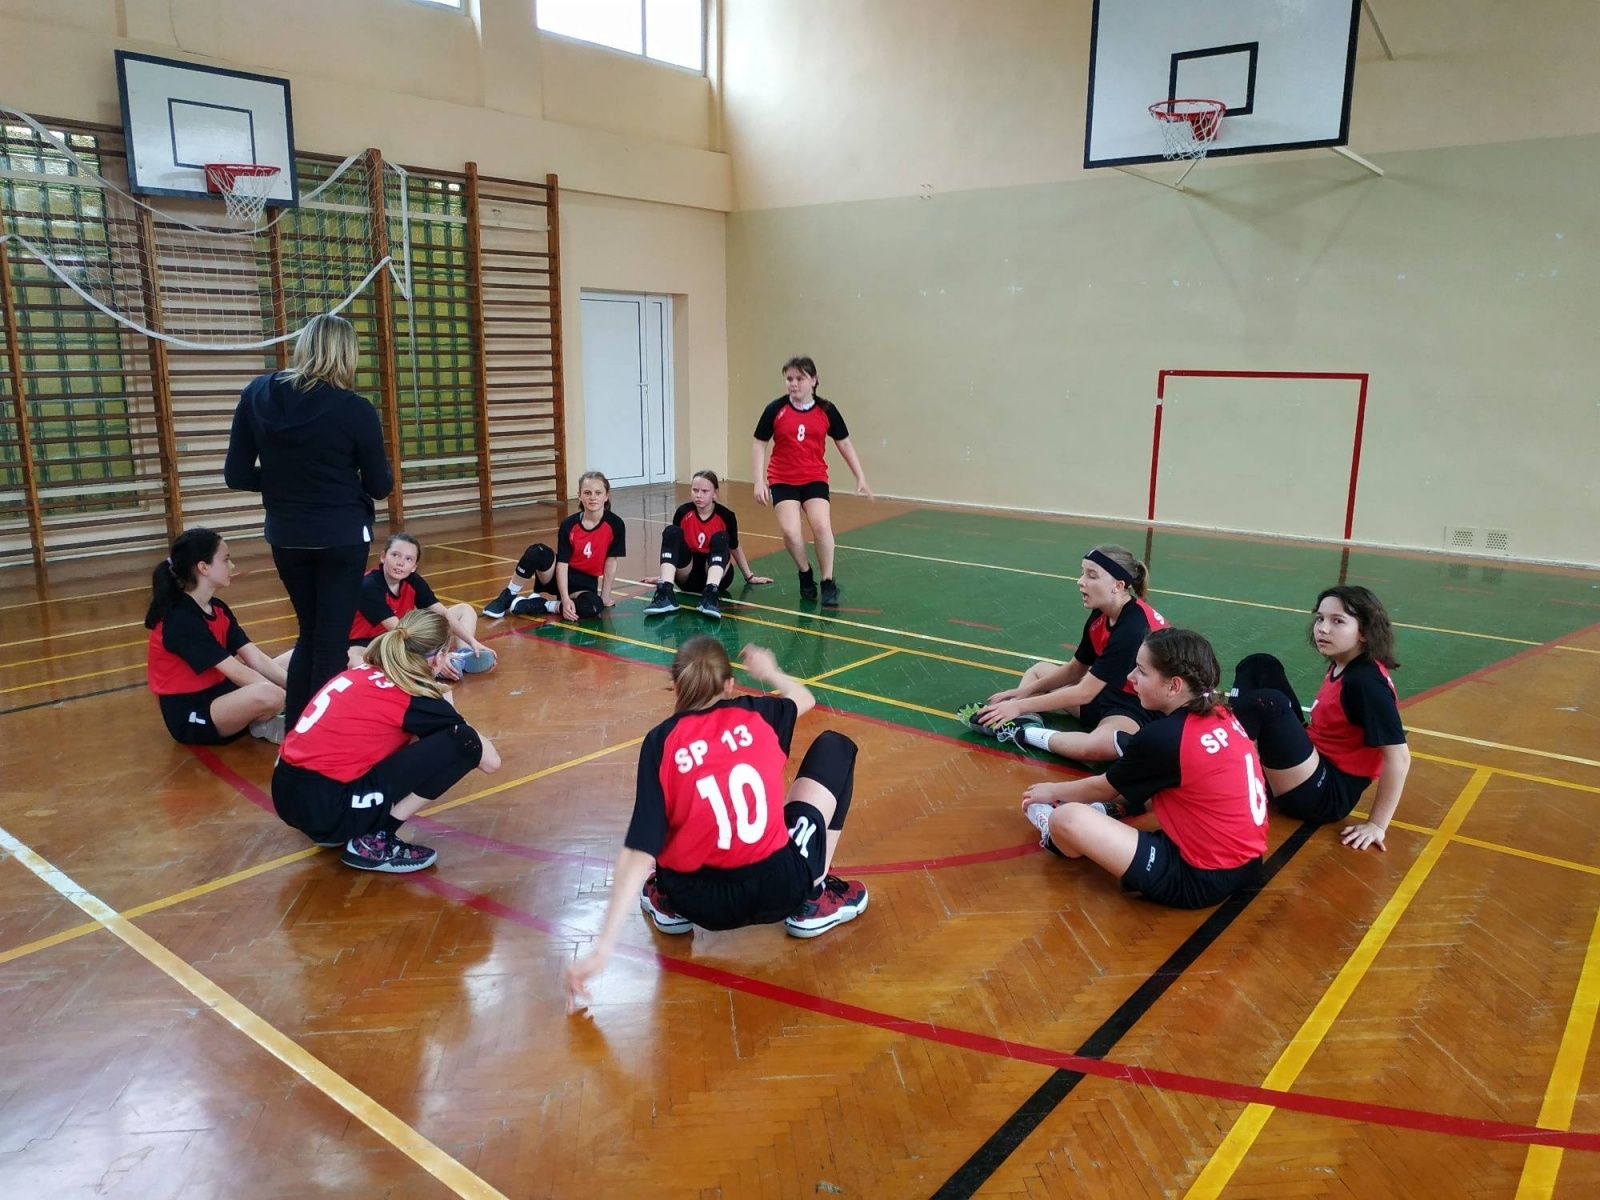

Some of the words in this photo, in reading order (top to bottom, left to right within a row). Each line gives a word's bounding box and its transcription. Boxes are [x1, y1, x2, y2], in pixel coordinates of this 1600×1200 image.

[797, 424, 806, 442] 8
[697, 532, 707, 549] 9
[583, 541, 592, 559] 4
[367, 671, 396, 689] 13
[294, 676, 353, 734] 5
[674, 739, 709, 774] SP
[720, 724, 754, 752] 13
[1200, 727, 1229, 754] SP
[351, 791, 384, 809] 5
[696, 763, 768, 850] 10
